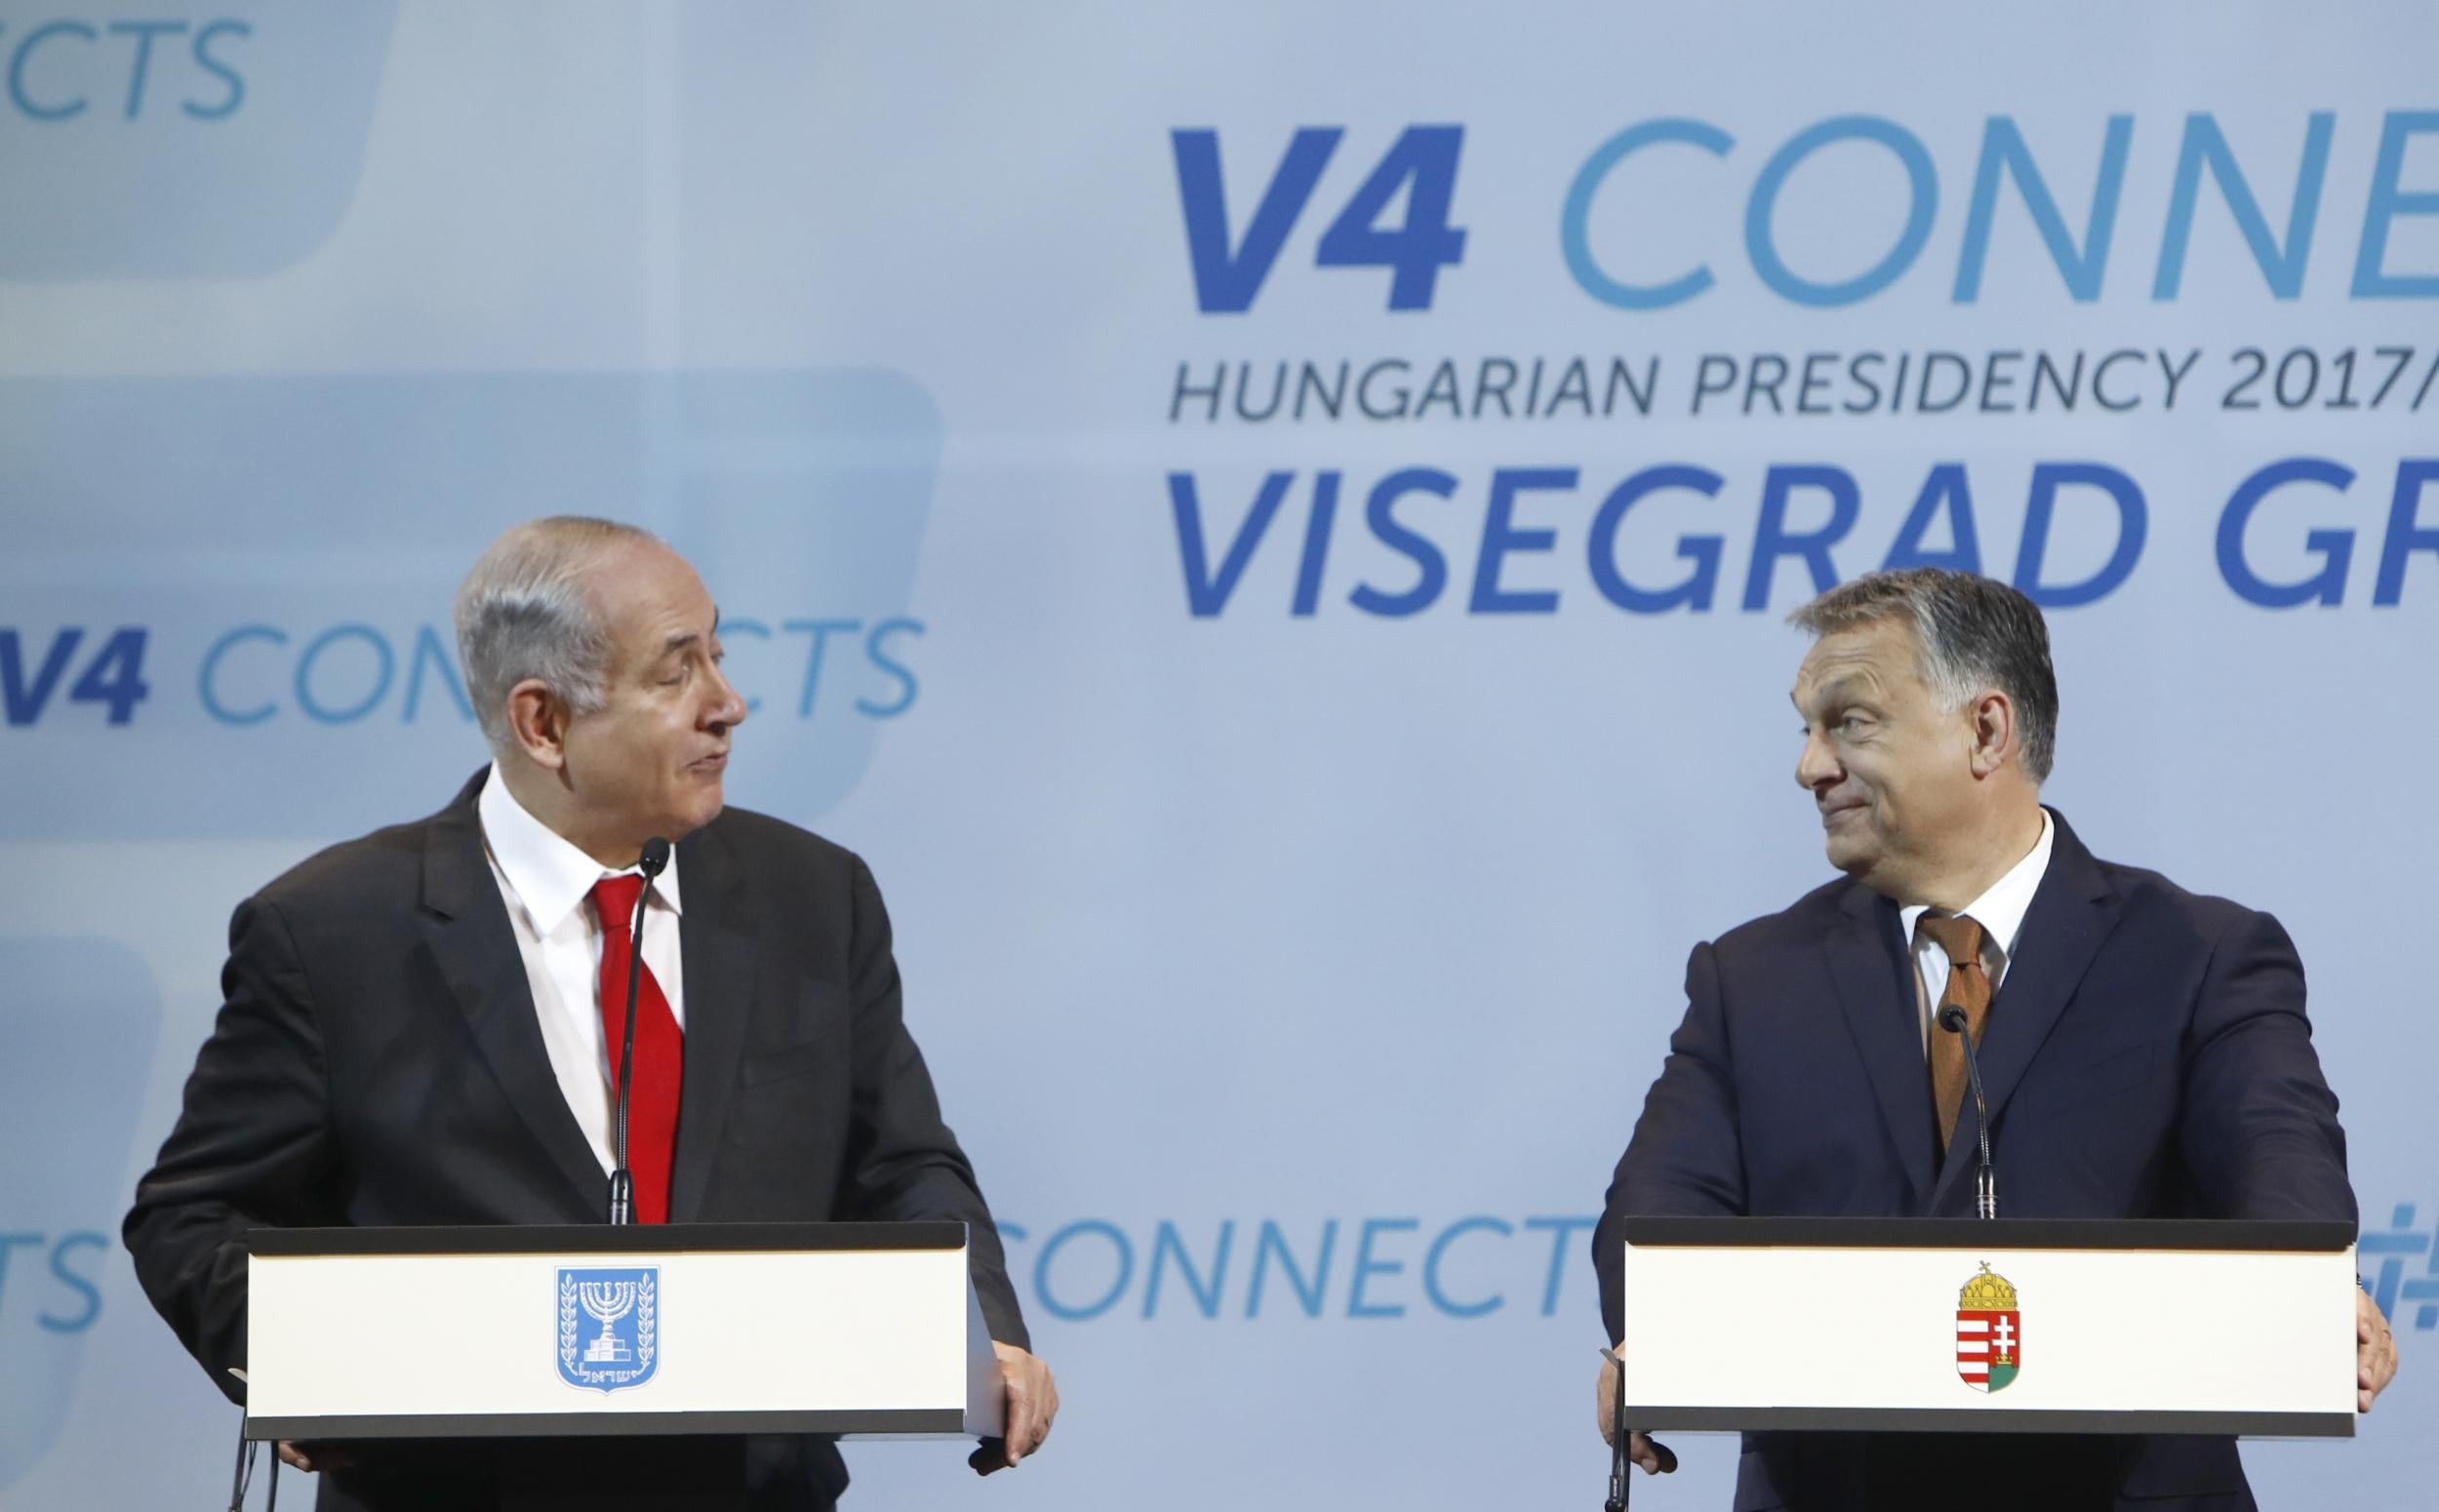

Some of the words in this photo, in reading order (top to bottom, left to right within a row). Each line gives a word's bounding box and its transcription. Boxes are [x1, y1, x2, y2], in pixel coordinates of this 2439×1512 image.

[0, 20, 253, 123] CTS
[1169, 123, 1468, 315] V4
[1560, 110, 2439, 311] CONNE
[1168, 355, 1660, 423] HUNGARIAN
[1689, 348, 2202, 417] PRESIDENCY
[1166, 460, 2149, 618] VISEGRAD
[0, 625, 150, 727] V4
[993, 1215, 1601, 1321] ONNECT
